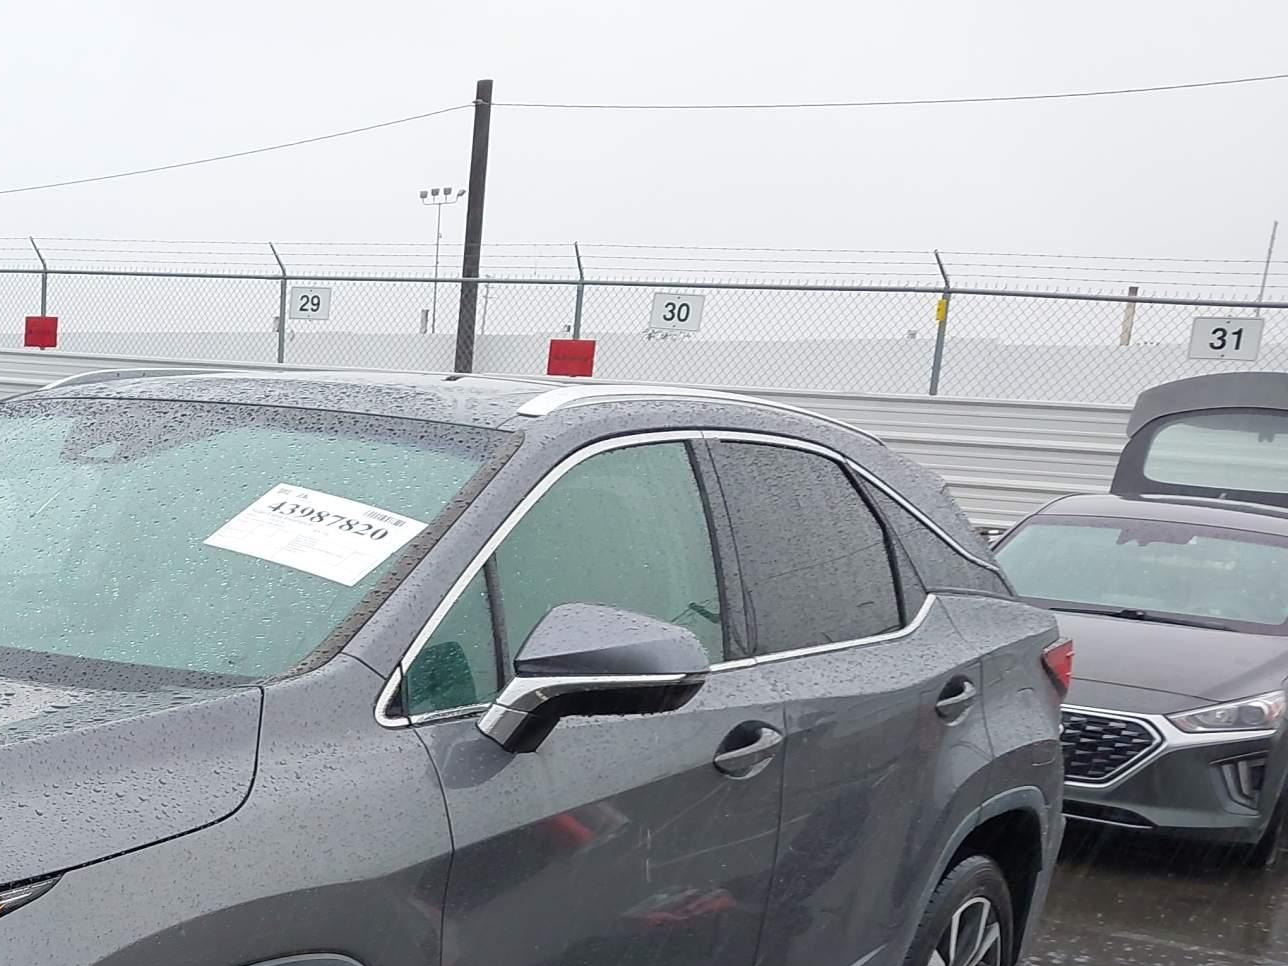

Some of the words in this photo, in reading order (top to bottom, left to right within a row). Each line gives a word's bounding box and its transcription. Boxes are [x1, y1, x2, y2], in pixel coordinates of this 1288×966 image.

[299, 294, 321, 313] 29
[662, 302, 691, 323] 30
[1209, 328, 1244, 351] 31
[268, 500, 389, 541] 43987820
